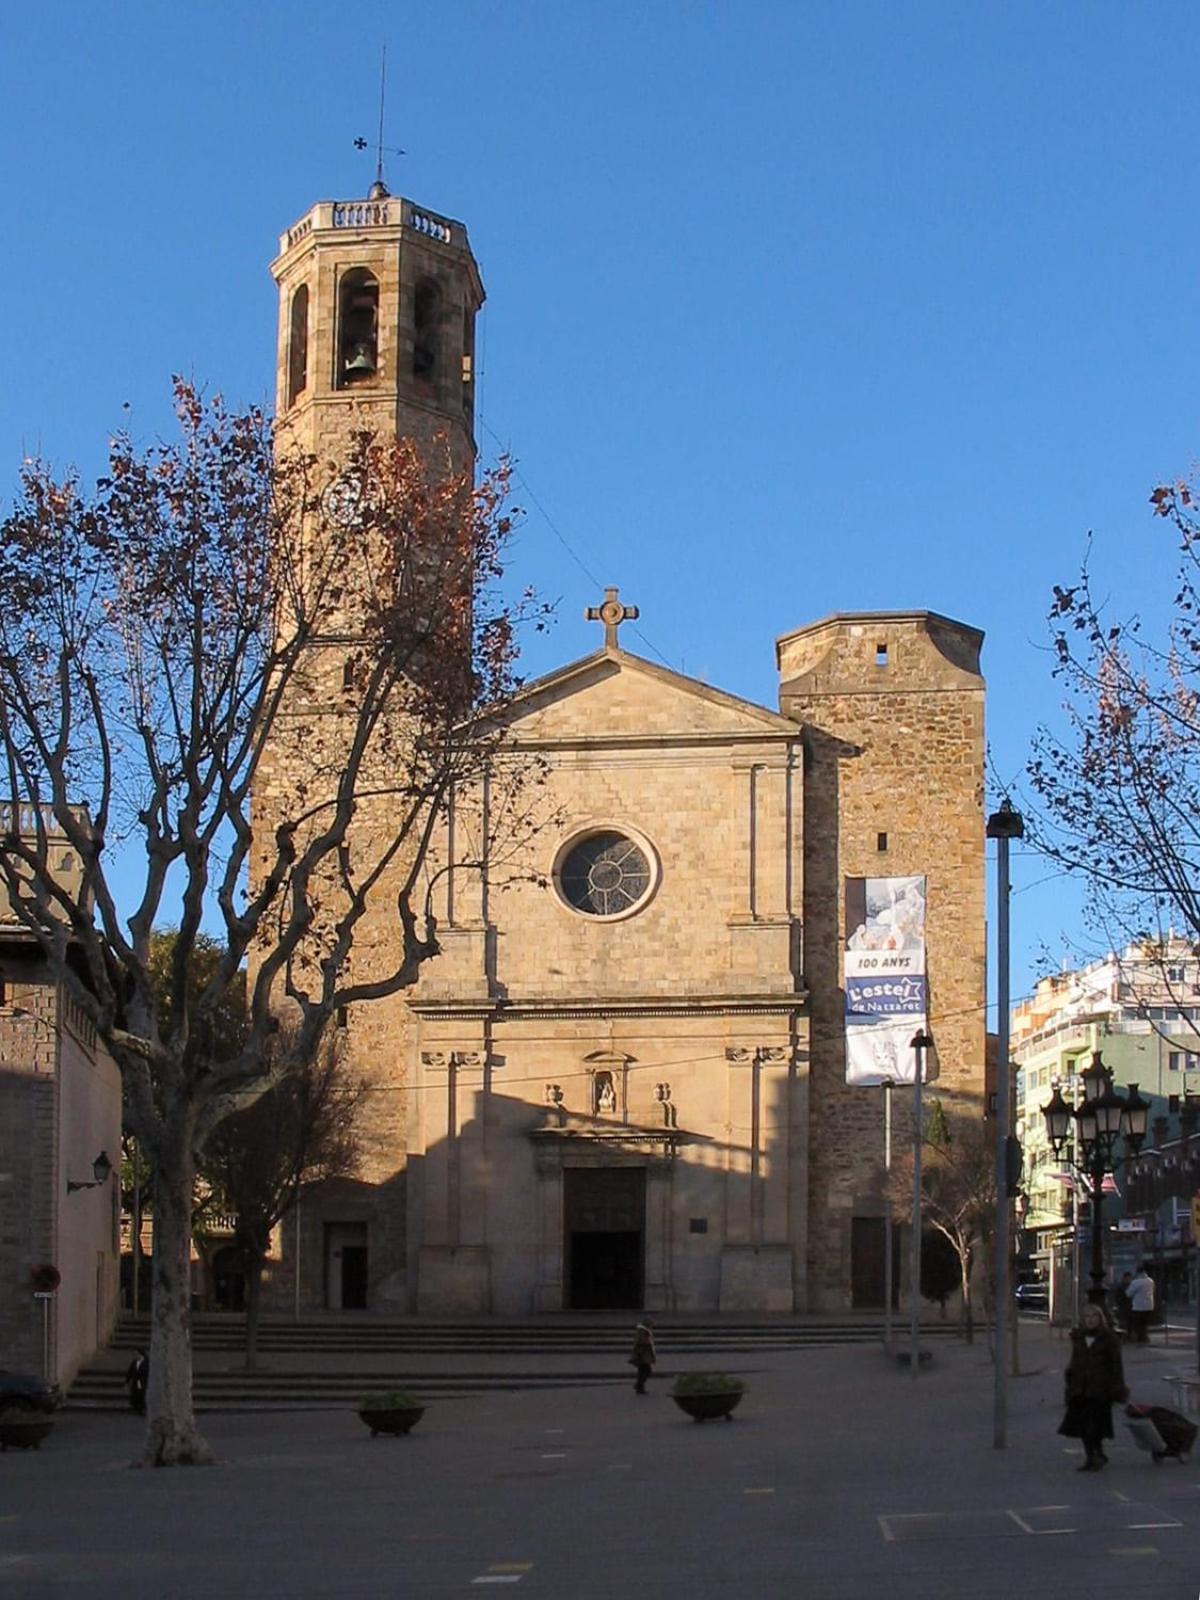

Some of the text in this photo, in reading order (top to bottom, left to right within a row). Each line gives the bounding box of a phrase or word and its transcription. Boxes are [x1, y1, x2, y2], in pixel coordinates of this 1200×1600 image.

[858, 957, 911, 969] 100 ANYS
[851, 1002, 920, 1012] de Natzaret
